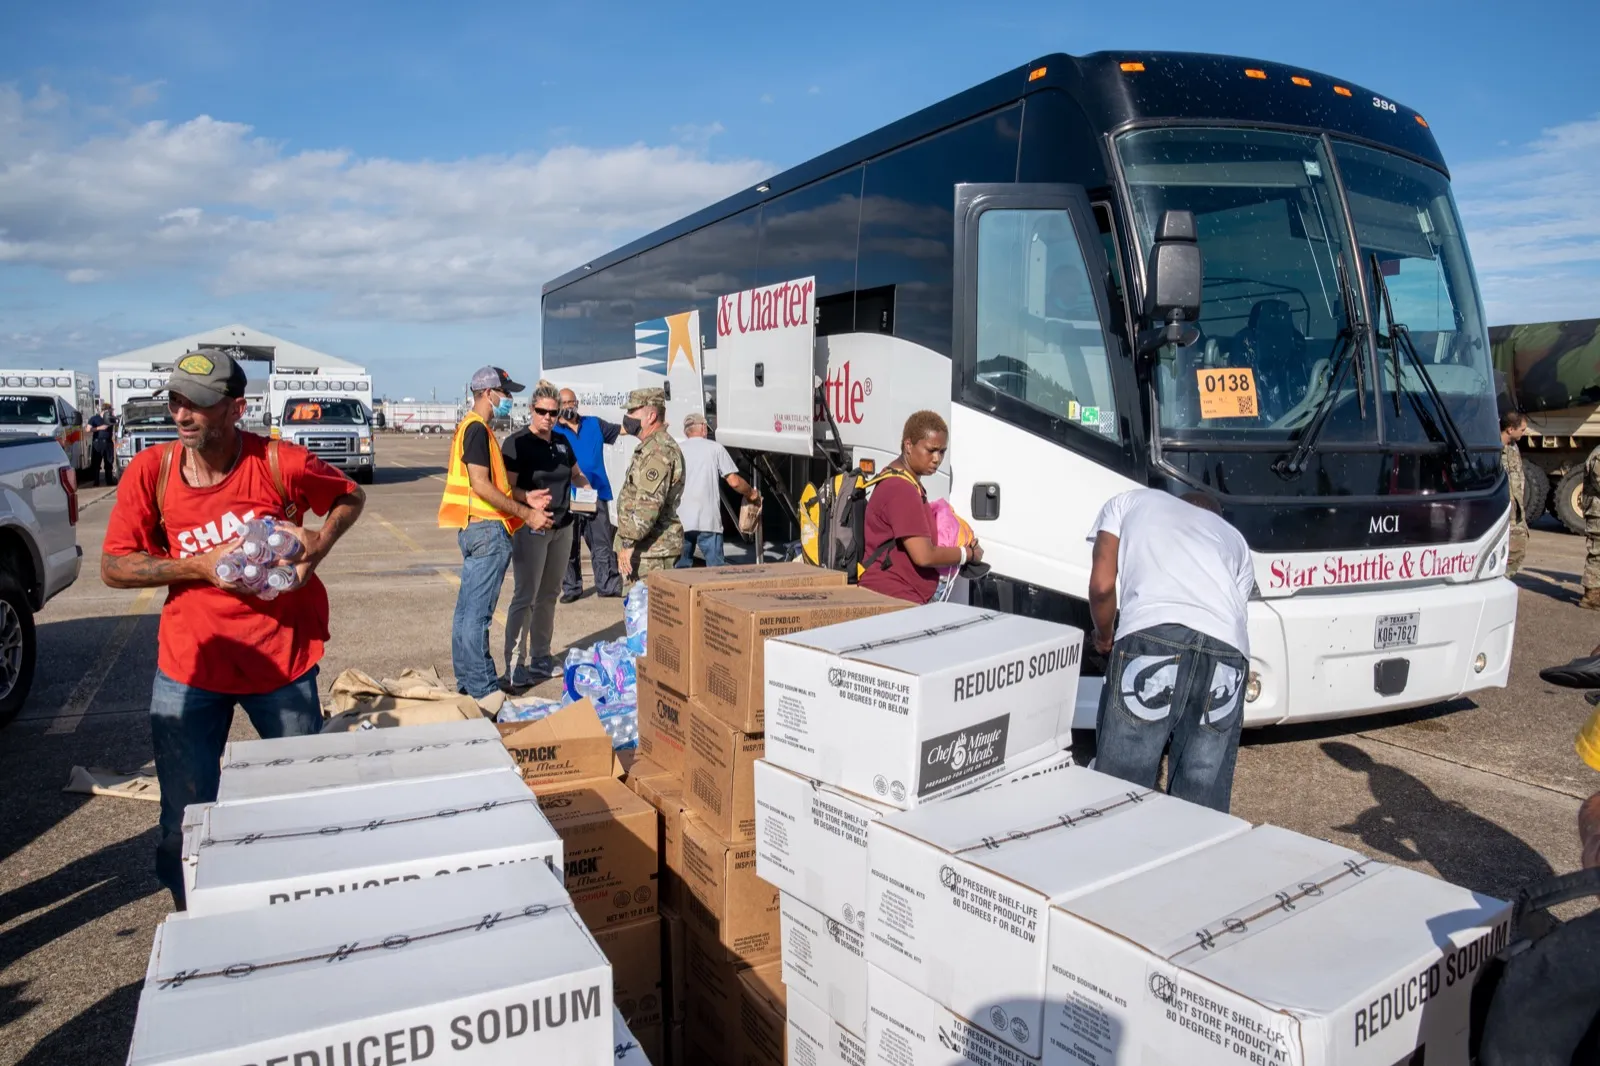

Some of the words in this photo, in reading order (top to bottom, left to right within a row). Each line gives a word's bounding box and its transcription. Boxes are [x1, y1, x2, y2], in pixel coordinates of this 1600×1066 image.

[1372, 97, 1396, 114] 394
[737, 281, 812, 334] Charter
[1205, 374, 1250, 392] 0138
[599, 392, 616, 405] Distance
[178, 510, 255, 552] CHA
[1369, 515, 1399, 533] MCI
[1270, 559, 1317, 588] Star
[1323, 553, 1394, 584] Shuttle
[1399, 551, 1415, 579] &
[1419, 549, 1479, 577] Charter
[760, 617, 774, 625] DATE
[848, 671, 876, 685] PRESERVE
[877, 679, 909, 694] SHELF-LIFE
[954, 660, 1024, 702] REDUCED
[1029, 643, 1080, 679] SODIUM
[847, 692, 872, 705] DEGREES
[878, 700, 887, 710] OR
[888, 703, 908, 715] BELOW
[854, 683, 872, 695] STORE
[873, 688, 900, 703] PRODUCT
[902, 696, 909, 704] AT
[522, 745, 556, 762] PACK
[928, 739, 955, 765] Chef
[968, 729, 1002, 750] Minute
[966, 743, 994, 766] Meals
[537, 760, 574, 771] Meal
[925, 774, 951, 789] PREPARED
[964, 766, 973, 774] LIFE
[812, 807, 824, 818] MUST
[825, 813, 840, 826] STORE
[841, 819, 864, 837] PRODUCT
[813, 798, 818, 806] TO
[820, 801, 843, 817] PRESERVE
[844, 811, 868, 827] SHELF-LIF
[820, 821, 840, 836] DEGREES
[846, 833, 853, 841] OR
[854, 836, 868, 848] BELO
[564, 857, 598, 877] PACK
[735, 851, 750, 859] DATE
[735, 861, 756, 869] INSP/TE
[578, 871, 615, 886] Meal
[871, 868, 888, 882] REDUCED
[916, 890, 925, 900] KITS
[963, 876, 996, 900] PRESERVE
[998, 893, 1037, 919] SHELF-LIFE
[953, 897, 960, 908] 80
[962, 901, 992, 922] DEGREES
[993, 916, 997, 924] F
[999, 919, 1009, 931] OR
[1011, 924, 1035, 943] BELOW
[970, 892, 992, 910] STORE
[993, 903, 1026, 926] PRODUCT
[1027, 920, 1037, 931] AT
[1052, 964, 1076, 981] REDUCED
[1076, 977, 1098, 992] SODIUM
[1099, 987, 1113, 1001] MEAL
[1114, 995, 1127, 1008] KITS
[1355, 963, 1440, 1048] REDUCED
[1446, 920, 1508, 987] SODIUM
[871, 1006, 888, 1020] REDUCED
[1180, 987, 1229, 1018] PRESERVE
[244, 1024, 434, 1066] DUCED
[450, 985, 600, 1050] SODIUM
[954, 1020, 961, 1030] TO
[964, 1026, 996, 1051] PRESERVE
[1166, 1009, 1176, 1022] 80
[1179, 1016, 1221, 1045] DEGREES
[1224, 1038, 1231, 1048] F
[1233, 1042, 1247, 1059] OR
[1191, 1008, 1222, 1030] STORE
[1224, 1023, 1272, 1055] PRODUCT
[1274, 1048, 1288, 1063] AT
[839, 1041, 851, 1054] MUST
[840, 1033, 846, 1042] TO
[847, 1038, 865, 1057] PRESER
[951, 1031, 968, 1046] MUST
[970, 1040, 992, 1059] STORE
[1056, 1042, 1077, 1057] REDUCED
